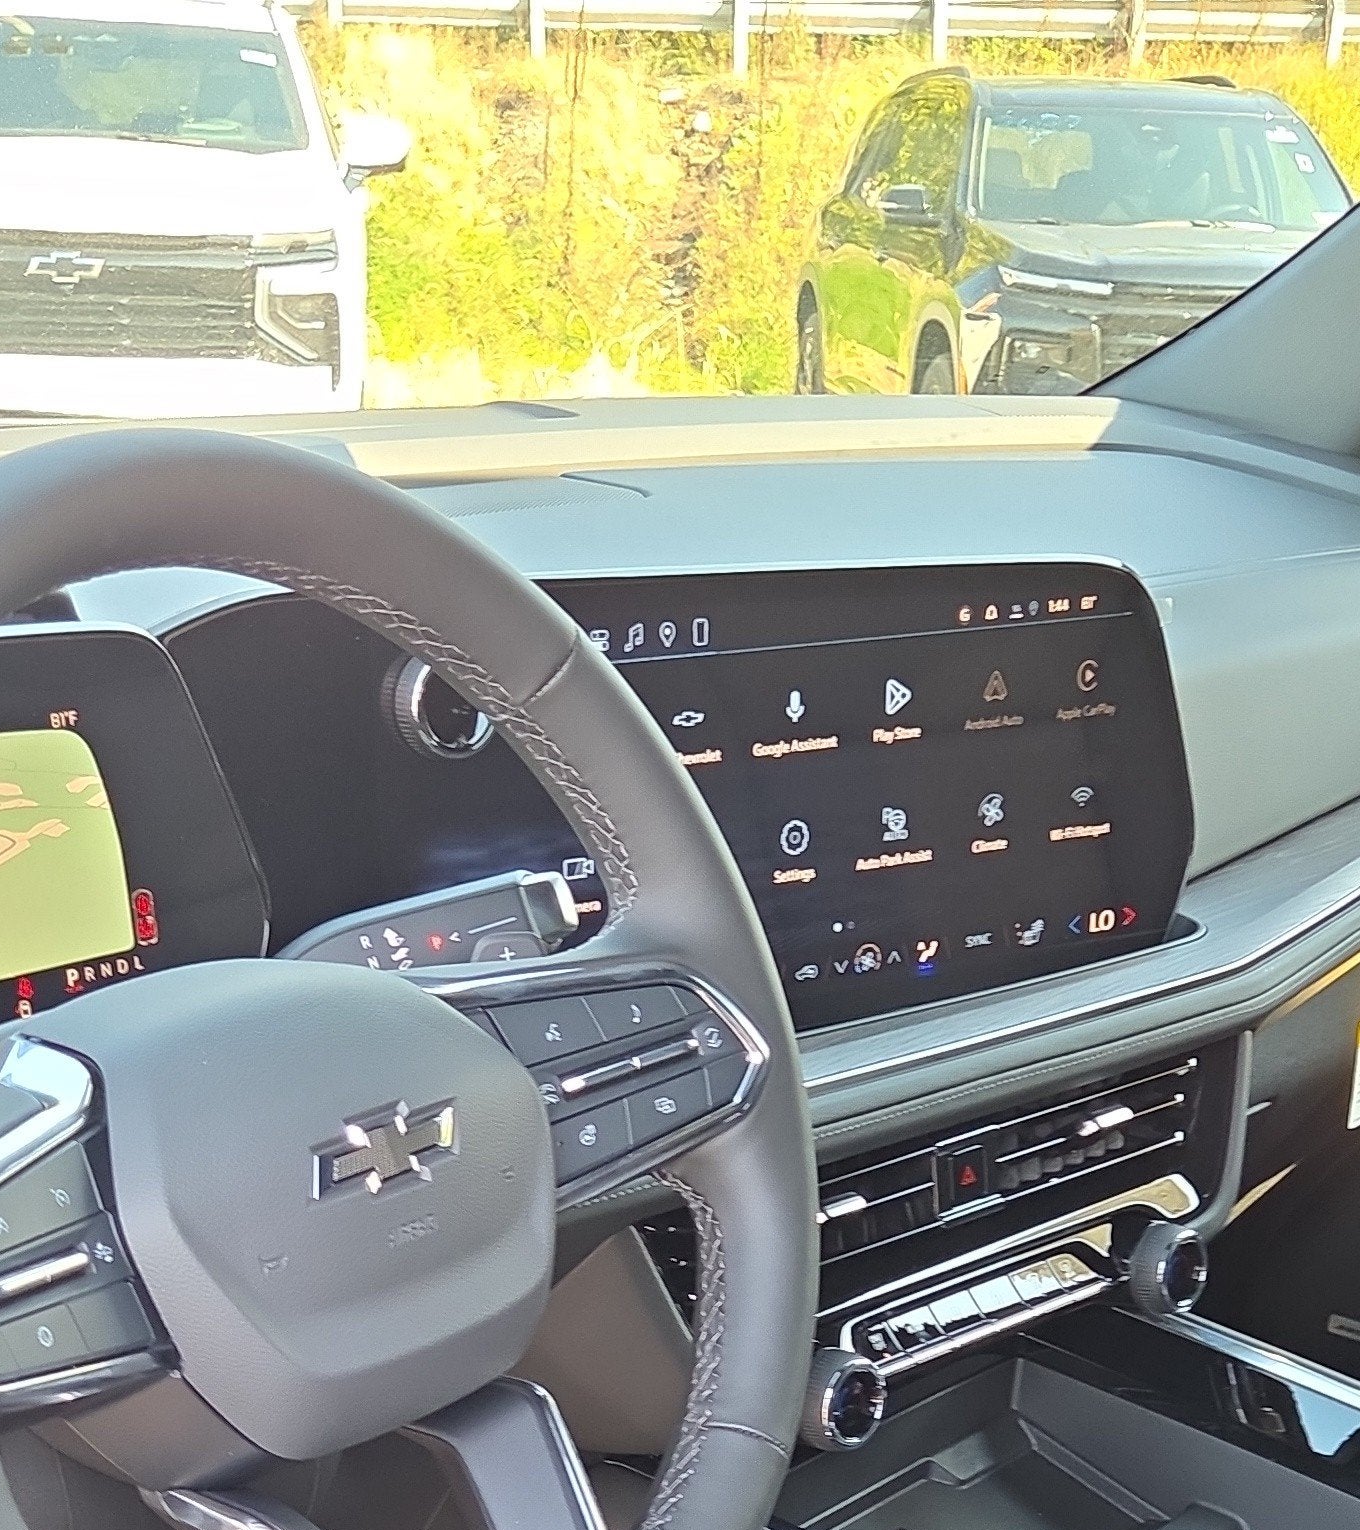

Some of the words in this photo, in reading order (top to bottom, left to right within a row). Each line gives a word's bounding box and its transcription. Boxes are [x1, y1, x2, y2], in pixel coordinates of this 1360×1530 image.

[872, 728, 895, 744] Play
[894, 725, 923, 740] Store
[751, 741, 790, 758] Google
[790, 735, 839, 753] Assistant
[675, 749, 723, 766] hevrolet
[854, 858, 881, 872] Auto
[880, 852, 903, 867] Park
[902, 848, 934, 864] Assist
[771, 866, 817, 885] Settings
[1088, 908, 1116, 933] LO
[358, 934, 372, 950] R
[65, 968, 80, 988] P
[83, 966, 97, 983] R
[99, 962, 114, 979] N
[115, 958, 130, 975] D
[132, 955, 145, 971] L
[366, 955, 381, 970] N
